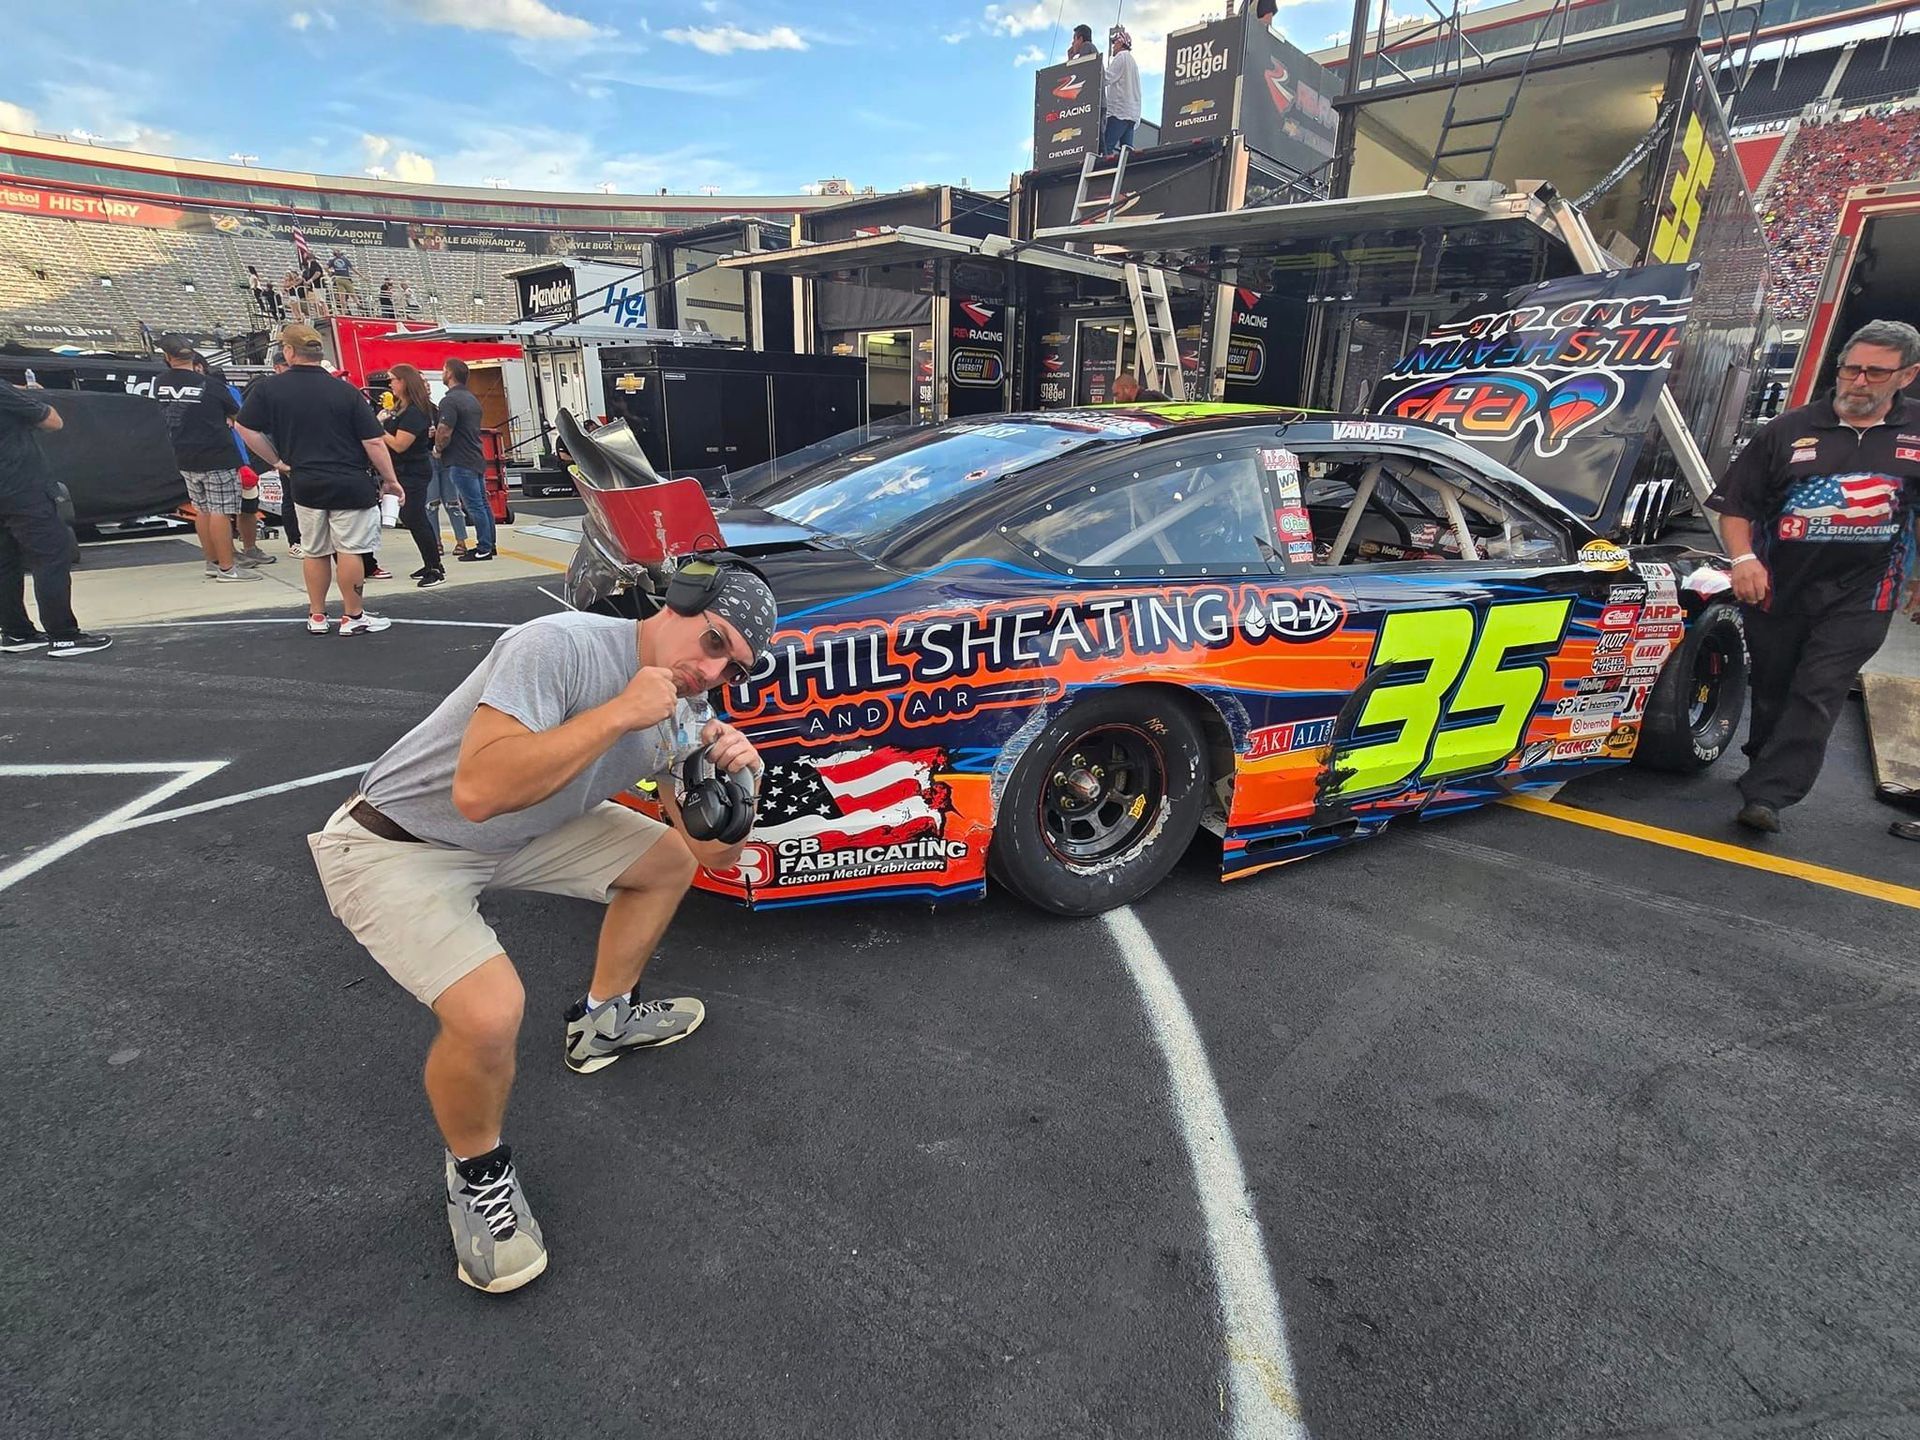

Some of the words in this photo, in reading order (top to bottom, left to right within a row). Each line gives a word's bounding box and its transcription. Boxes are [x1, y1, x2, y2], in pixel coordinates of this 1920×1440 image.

[1176, 39, 1215, 65] max
[1174, 48, 1229, 80] Siegel
[1175, 113, 1218, 128] CHEVROLET
[1049, 145, 1084, 158] CHEVROLET
[50, 196, 141, 218] HISTORY
[435, 235, 459, 244] DALE
[461, 236, 515, 247] EARNHARDT
[528, 279, 572, 314] Hendrick
[157, 386, 203, 399] SVG
[1809, 517, 1832, 526] CB
[1807, 524, 1900, 535] FABRICATING
[1643, 606, 1681, 619] ARP
[1638, 625, 1679, 633] PYROTECT
[1599, 633, 1629, 649] KLOTZ
[1626, 666, 1655, 676] LINCOLN
[1581, 677, 1606, 693] Holley
[1327, 599, 1572, 798] 35
[809, 707, 882, 734] AND
[912, 691, 969, 715] AIR
[1582, 717, 1610, 731] brembo
[1247, 729, 1291, 756] ZAKI
[1294, 725, 1326, 746] ALI
[1557, 740, 1591, 754] COMP
[1609, 734, 1634, 746] CALLIES
[778, 838, 820, 857] CB
[779, 840, 967, 874] FABRICATING
[778, 872, 830, 886] Custom
[834, 864, 871, 879] Metal
